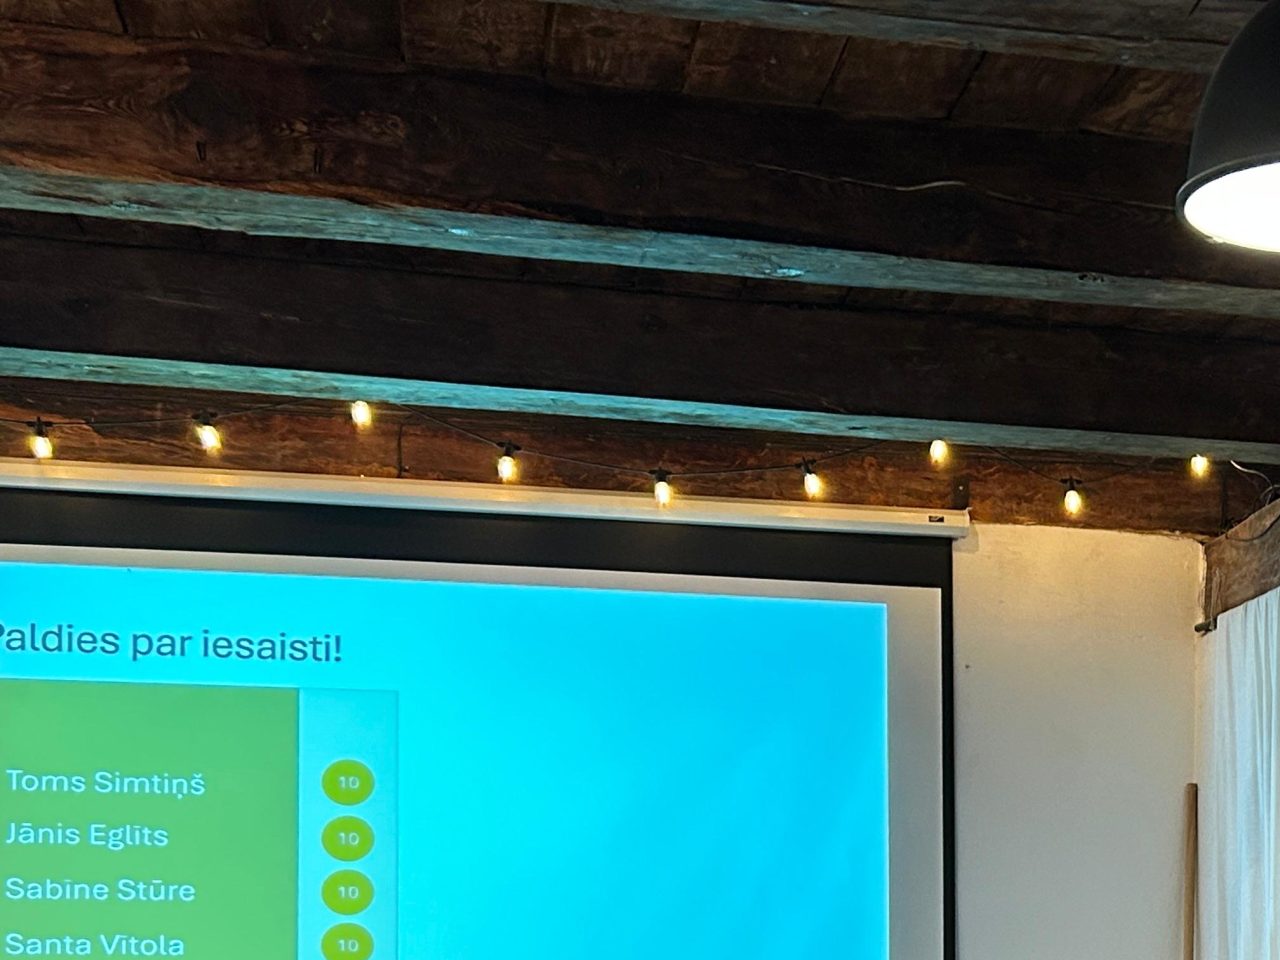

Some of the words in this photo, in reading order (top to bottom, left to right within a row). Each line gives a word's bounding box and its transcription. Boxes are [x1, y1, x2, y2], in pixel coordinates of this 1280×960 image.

[132, 632, 193, 662] par
[202, 629, 342, 662] iesaisti!
[6, 769, 86, 792] Toms
[94, 771, 206, 800] Simtiņš
[338, 776, 360, 789] 10
[6, 822, 81, 845] Jānis
[89, 823, 169, 851] Eglīts
[338, 832, 360, 845] 10
[5, 877, 110, 900] Sabīne
[117, 878, 196, 902] Stūre
[338, 886, 359, 899] 10
[5, 932, 92, 956] Santa
[99, 933, 185, 957] Vītola
[337, 939, 359, 952] 10
